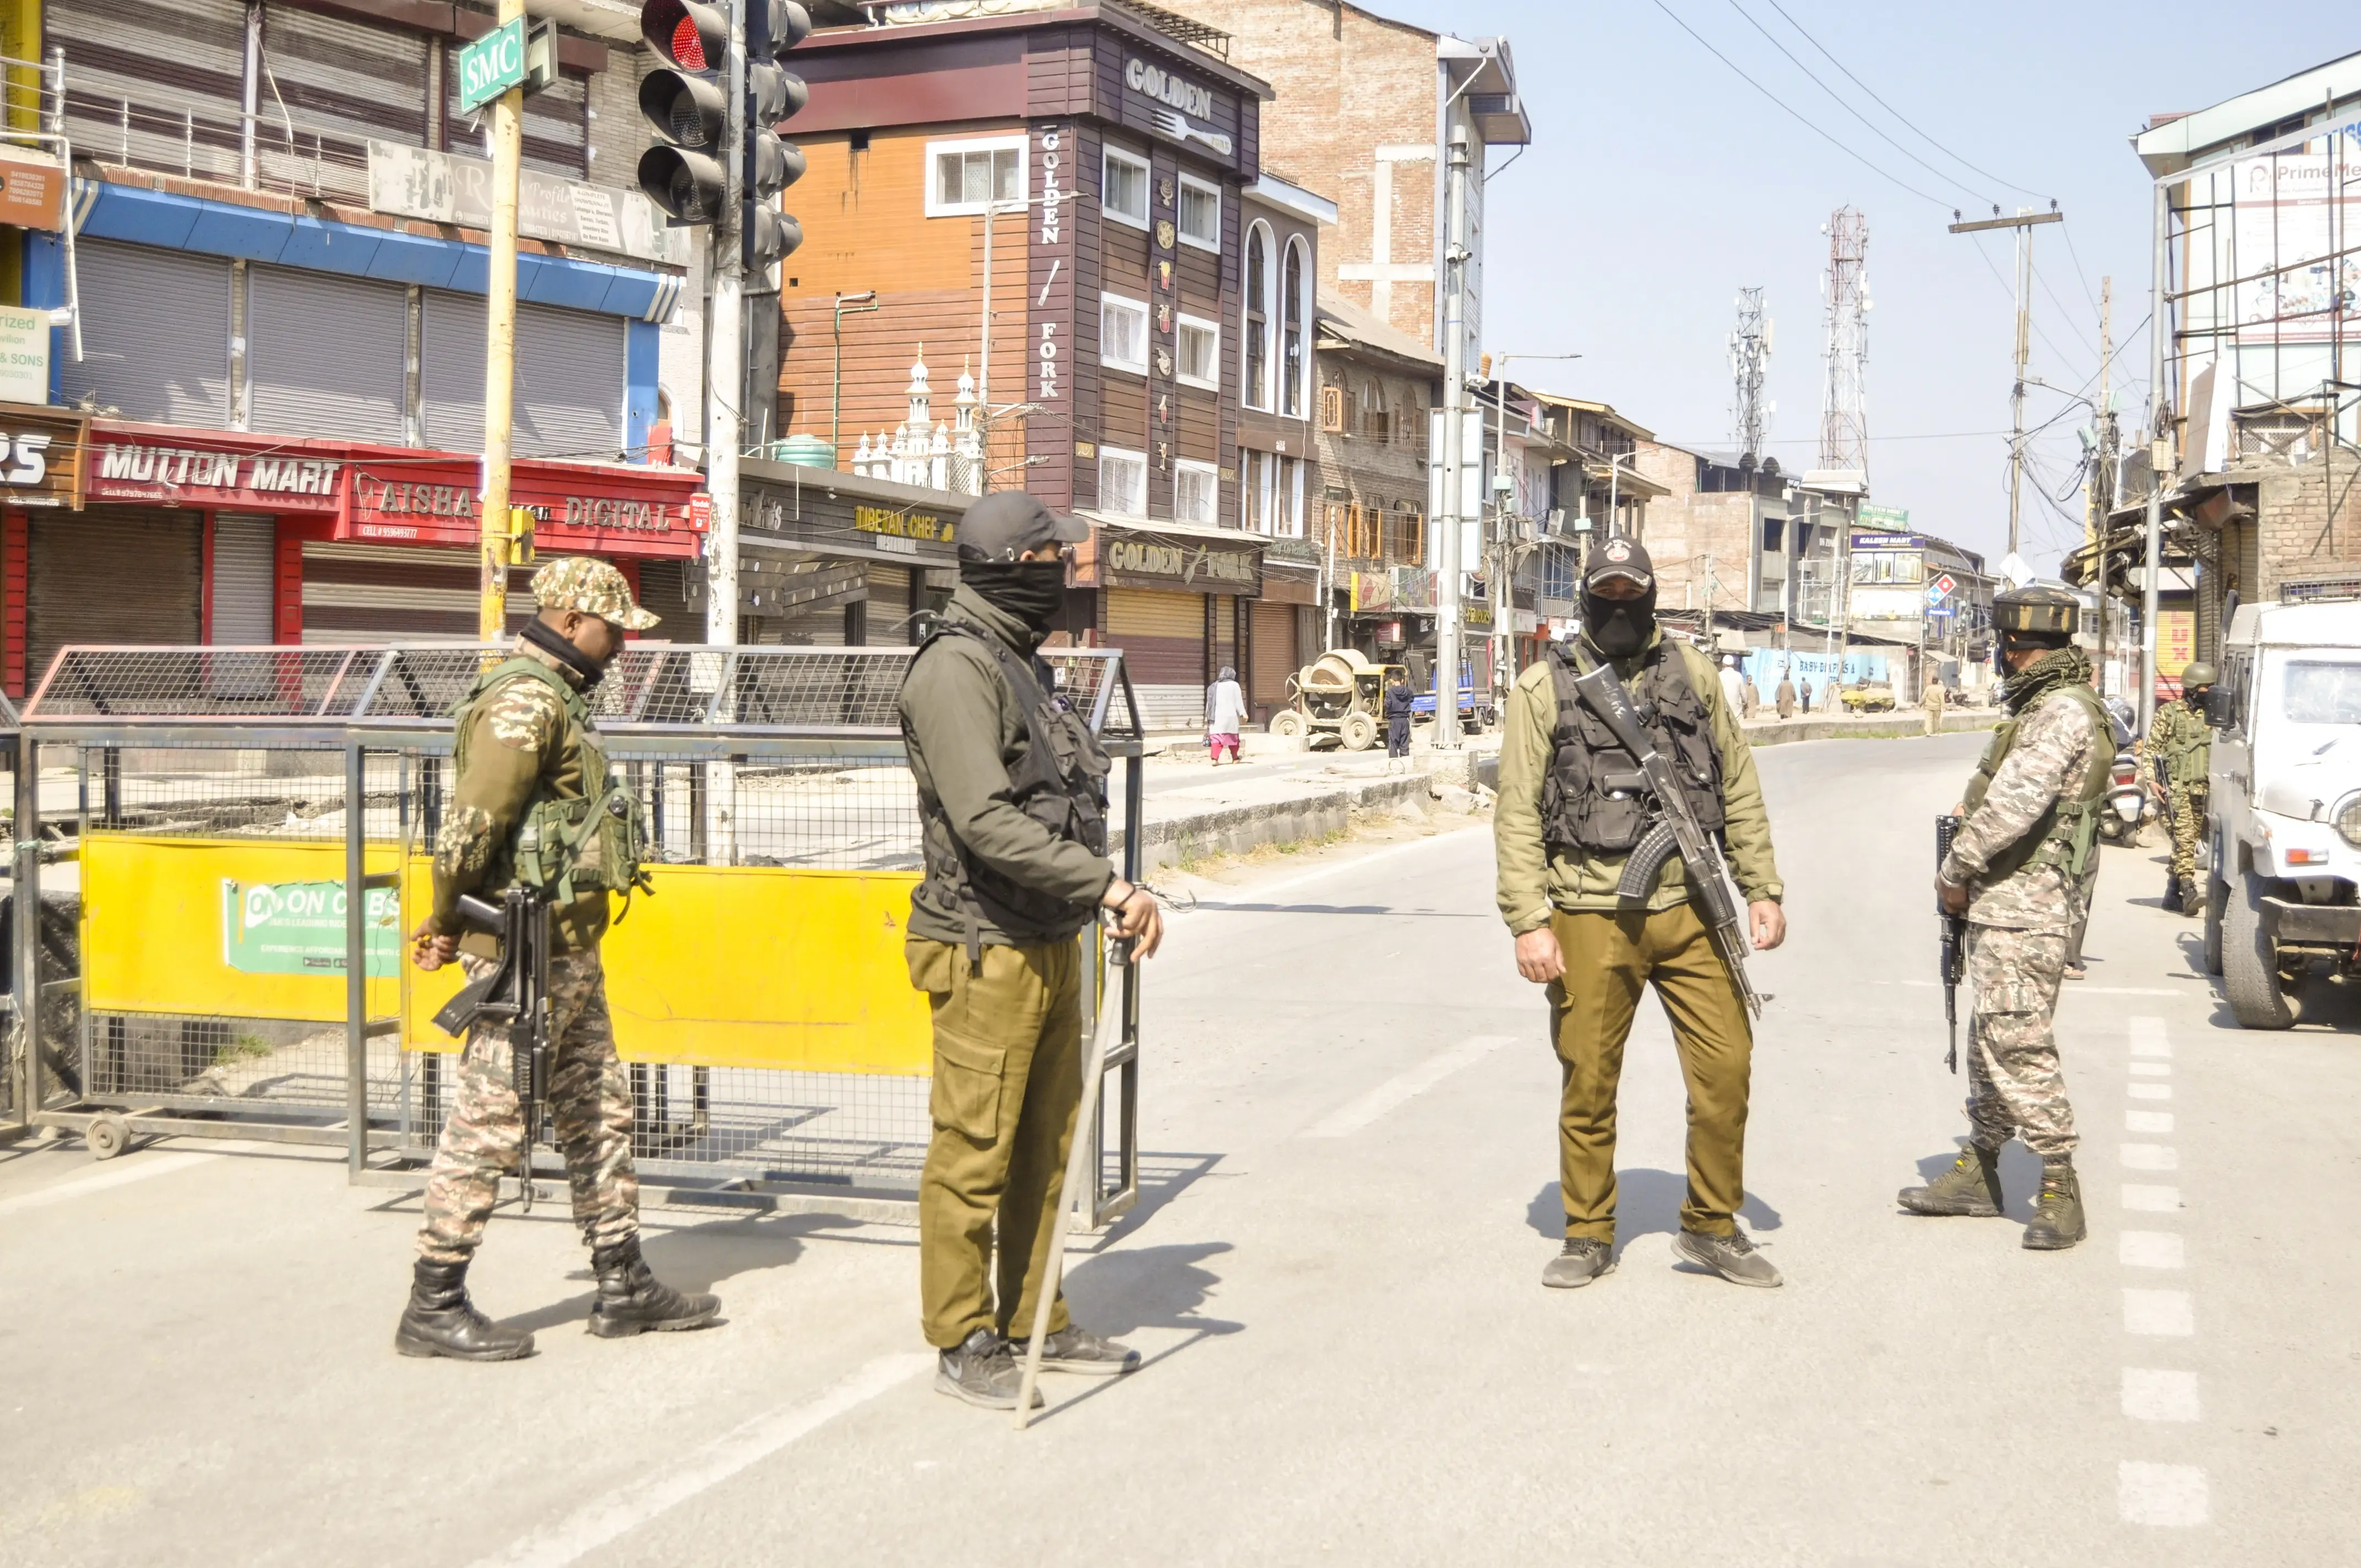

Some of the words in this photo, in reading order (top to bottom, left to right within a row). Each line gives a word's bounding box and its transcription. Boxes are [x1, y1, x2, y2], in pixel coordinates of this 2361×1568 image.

[467, 34, 517, 95] SMC
[1126, 58, 1212, 121] GOLDEN
[529, 182, 570, 205] Profile
[1042, 133, 1060, 244] GOLDEN
[10, 353, 43, 367] SONS
[1040, 323, 1058, 398] FORK
[102, 443, 241, 488] MUTTON
[251, 456, 339, 496] MART
[379, 482, 474, 518] AISHA
[565, 497, 671, 531] DIGITAL
[692, 499, 710, 508] Kodak
[363, 526, 377, 536] CELL
[378, 526, 382, 536] #
[855, 505, 904, 536] TIBETAN
[907, 514, 938, 540] CHEF
[1109, 542, 1183, 575] GOLDEN
[1207, 551, 1253, 580] FORK
[2170, 609, 2189, 661] LUX
[1799, 661, 1818, 672] BABY
[287, 889, 326, 917] ON
[332, 890, 400, 916] CBS
